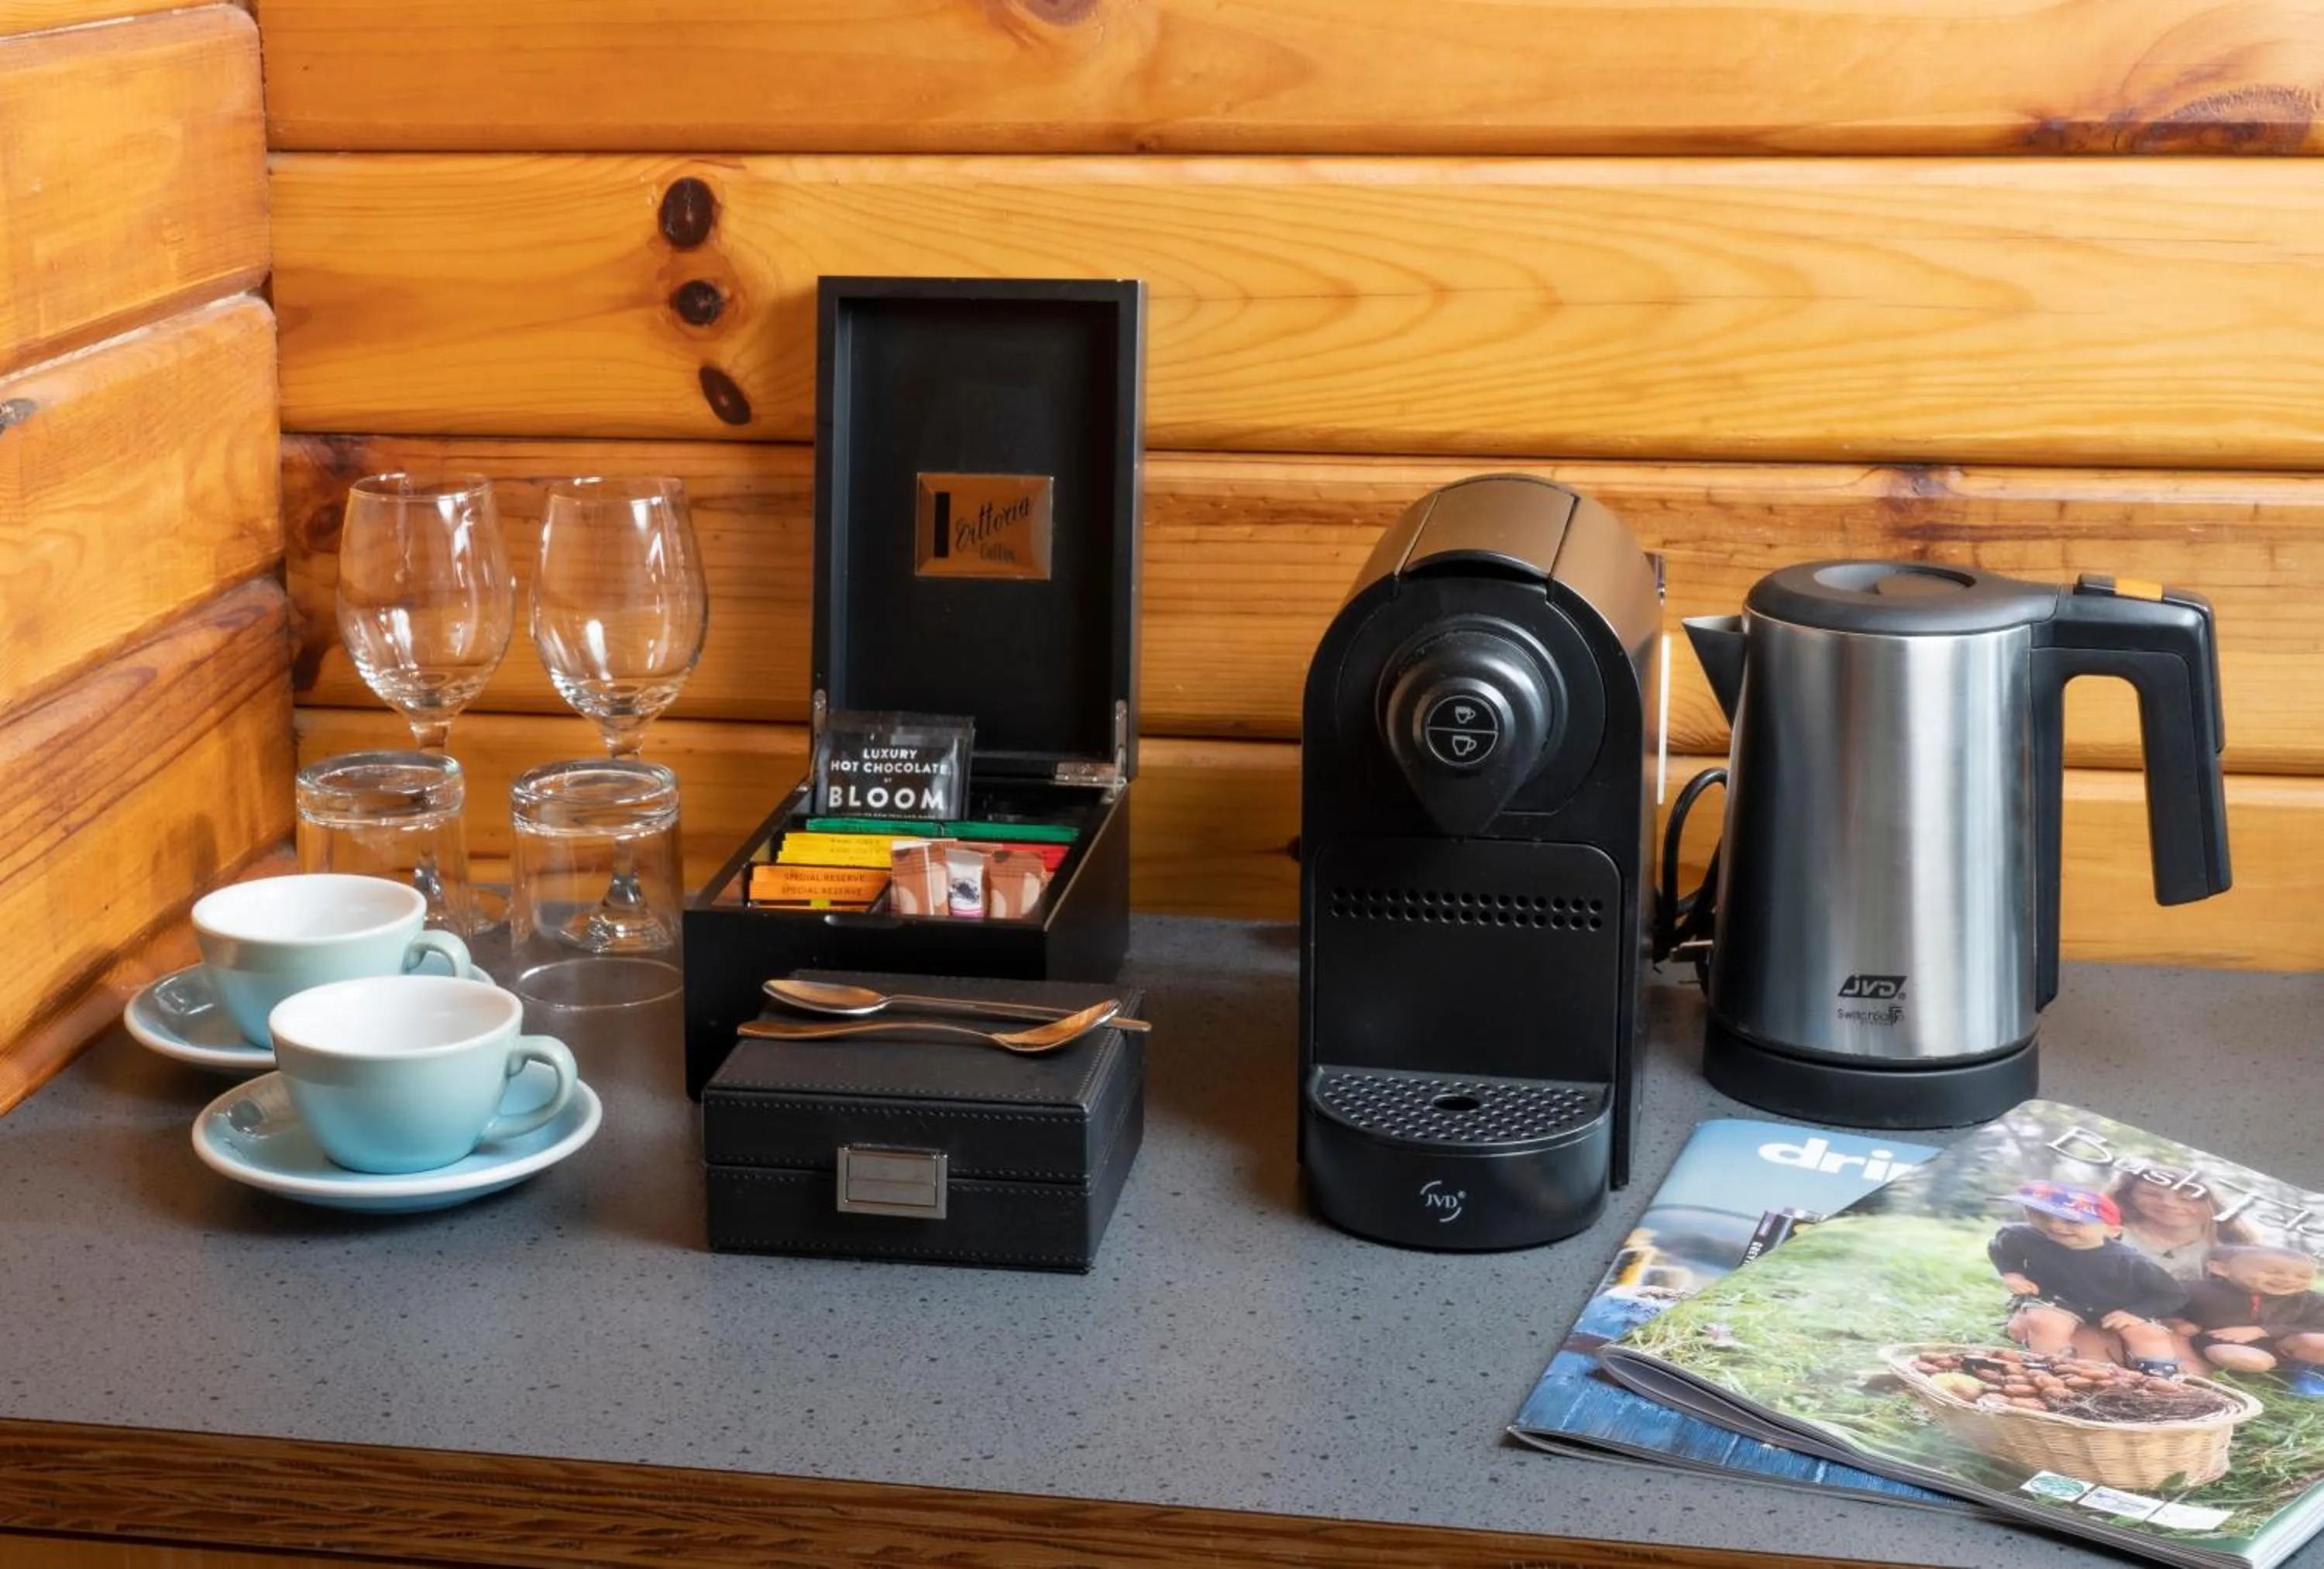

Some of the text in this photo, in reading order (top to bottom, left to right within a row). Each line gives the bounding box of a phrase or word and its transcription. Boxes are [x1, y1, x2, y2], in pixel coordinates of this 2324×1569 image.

[862, 747, 918, 760] LUXURY
[830, 760, 949, 774] HOT CHOCOLATE
[828, 785, 944, 810] BLOOM
[785, 872, 865, 883] SPECIAL RESERVE
[782, 885, 862, 896] SPECIAL RESERVE
[1841, 976, 1899, 997] JVD
[1425, 1193, 1459, 1209] JVD
